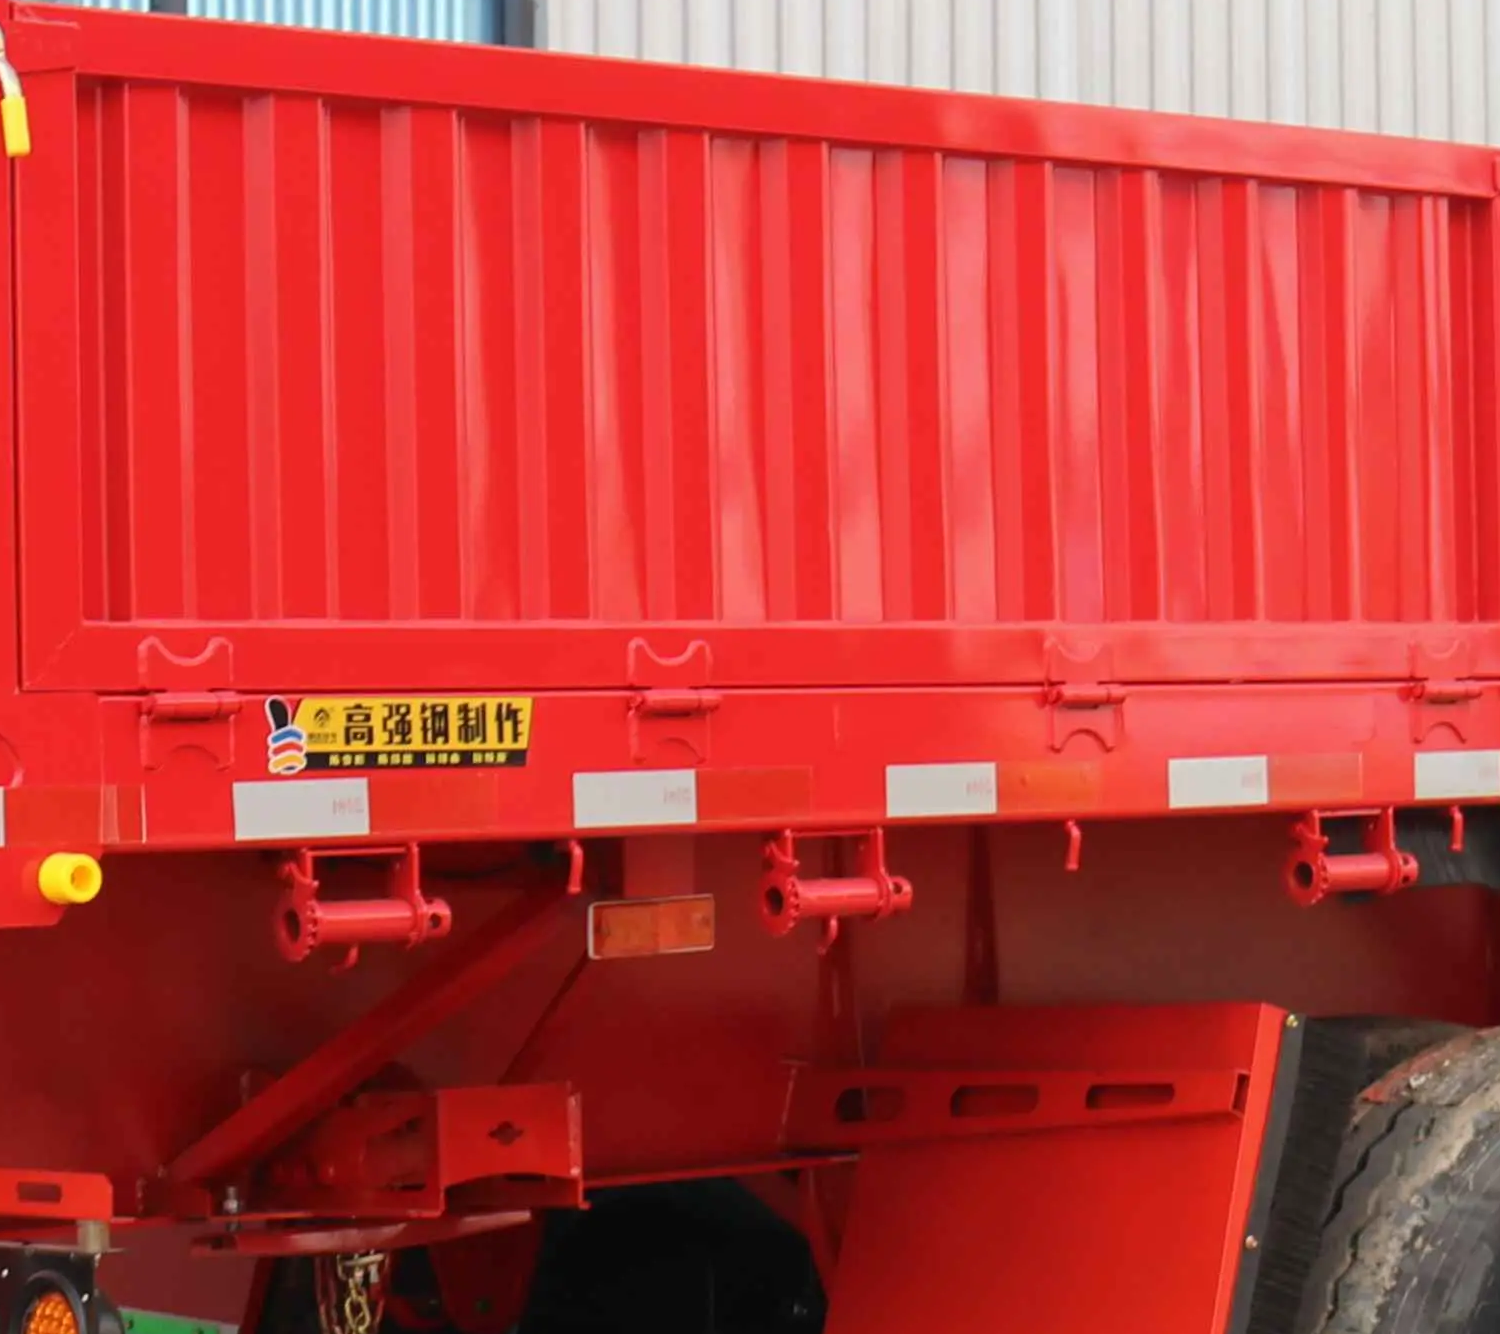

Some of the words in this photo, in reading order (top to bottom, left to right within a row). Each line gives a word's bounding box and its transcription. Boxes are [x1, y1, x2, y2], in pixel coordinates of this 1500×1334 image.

[342, 702, 525, 746] 高强钢制作
